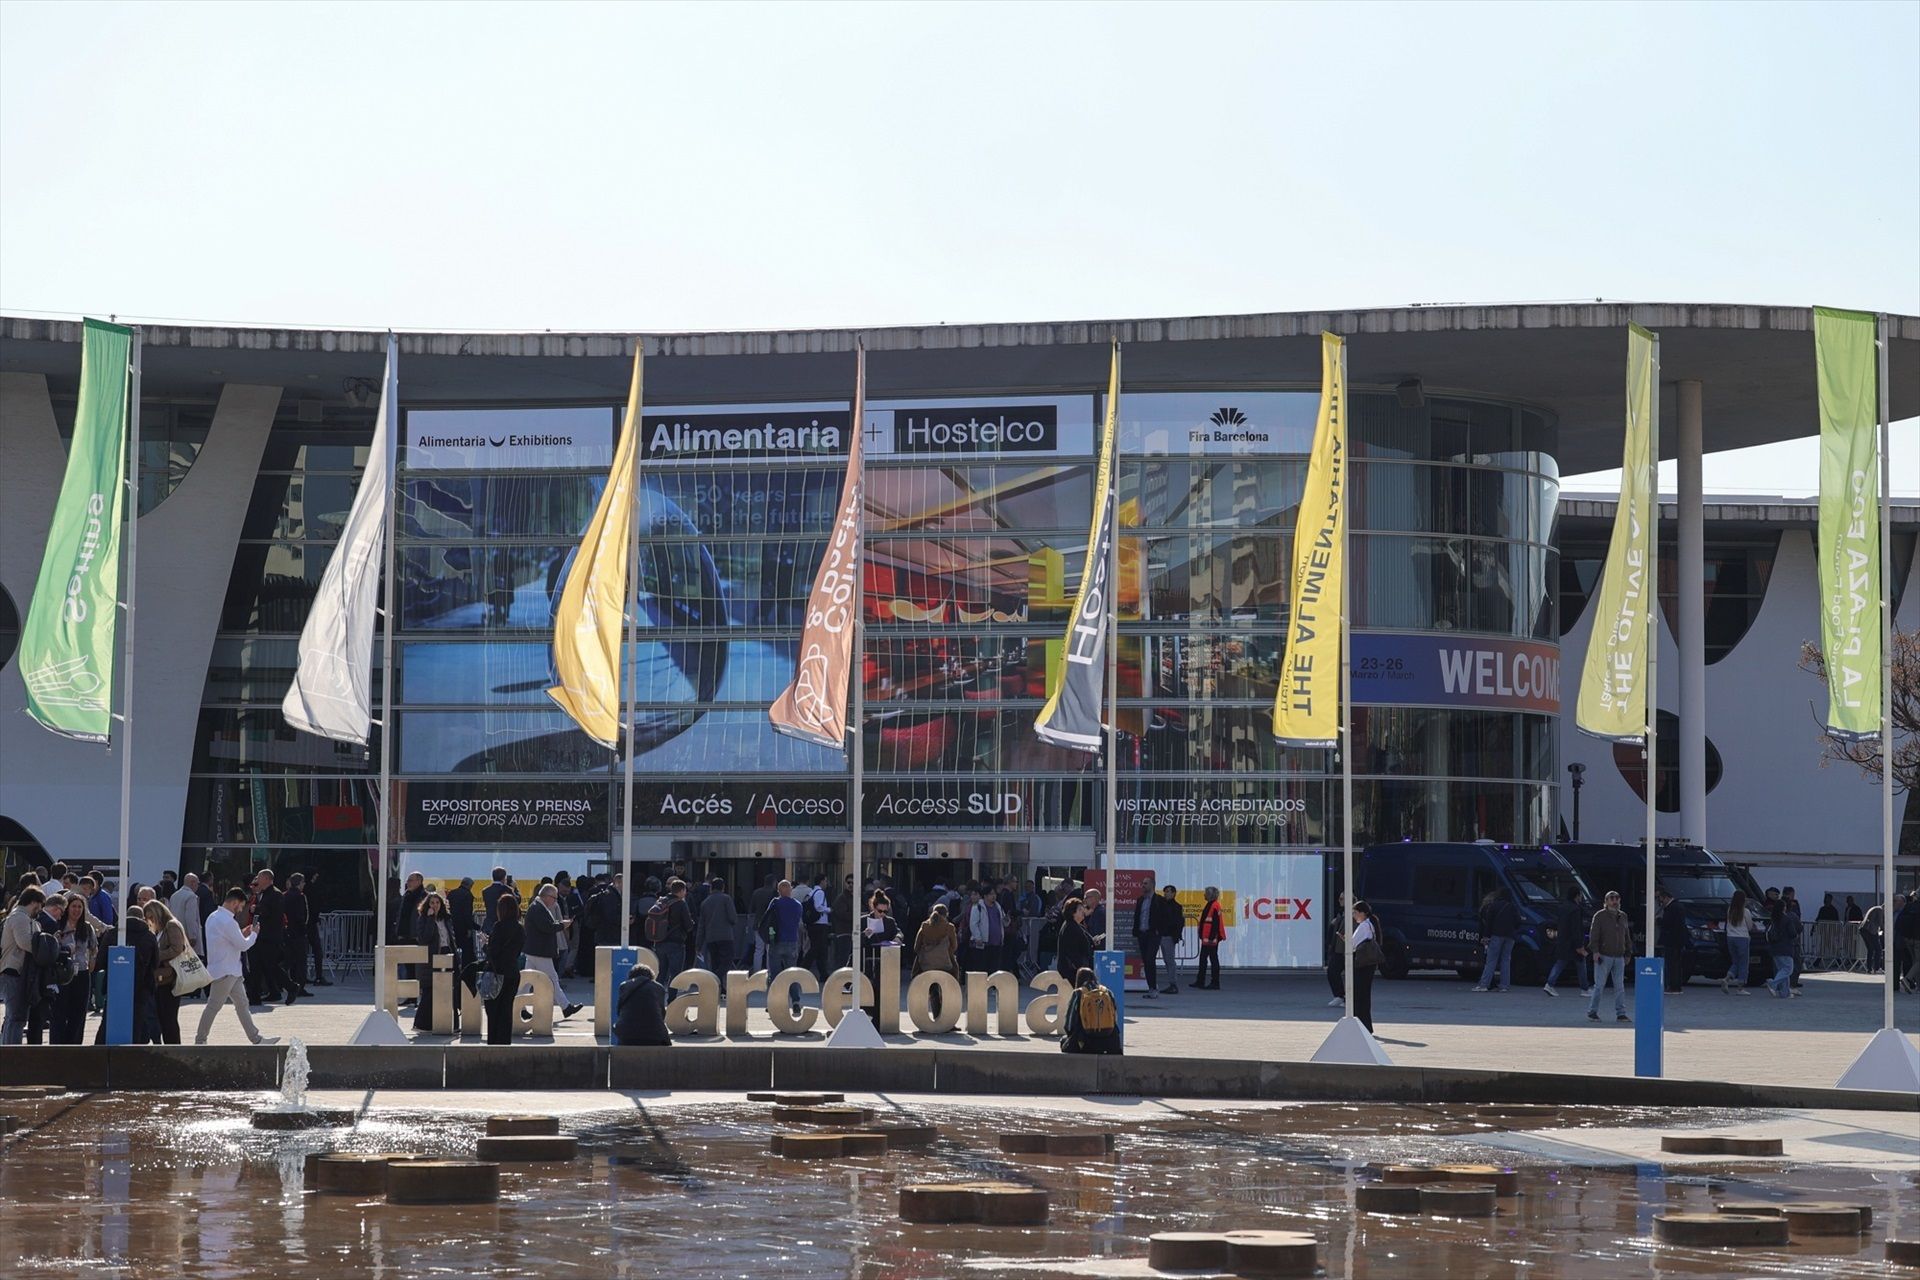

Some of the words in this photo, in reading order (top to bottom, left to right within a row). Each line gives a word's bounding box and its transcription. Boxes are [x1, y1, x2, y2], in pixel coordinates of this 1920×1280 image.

[649, 420, 841, 452] Alimentaria
[907, 416, 1045, 445] Hostelco
[1189, 431, 1210, 442] Fira
[1214, 431, 1269, 442] Barcelona
[418, 436, 486, 447] Alimentaria
[509, 435, 573, 447] Exhibitions
[695, 484, 722, 503] 50
[731, 488, 785, 506] years
[734, 510, 763, 526] the
[769, 509, 831, 525] future
[1360, 657, 1404, 671] 23-26
[1350, 670, 1379, 680] Marzo
[1387, 671, 1415, 681] March
[422, 799, 519, 812] EXPOSITORES
[523, 800, 532, 812] Y
[536, 799, 591, 812] PRENSA
[660, 793, 733, 814] Accés
[761, 793, 845, 814] Acceso
[876, 793, 960, 814] Access
[967, 793, 1023, 815] SUD
[1114, 799, 1197, 812] VISITANTES
[1200, 799, 1306, 812] ACREDITADOS
[427, 813, 506, 826] EXHIBITORS
[508, 813, 538, 826] AND
[540, 813, 585, 826] PRESS
[1132, 813, 1219, 826] REGISTERED
[1223, 813, 1287, 826] VISITORS
[1427, 928, 1457, 939] mossos
